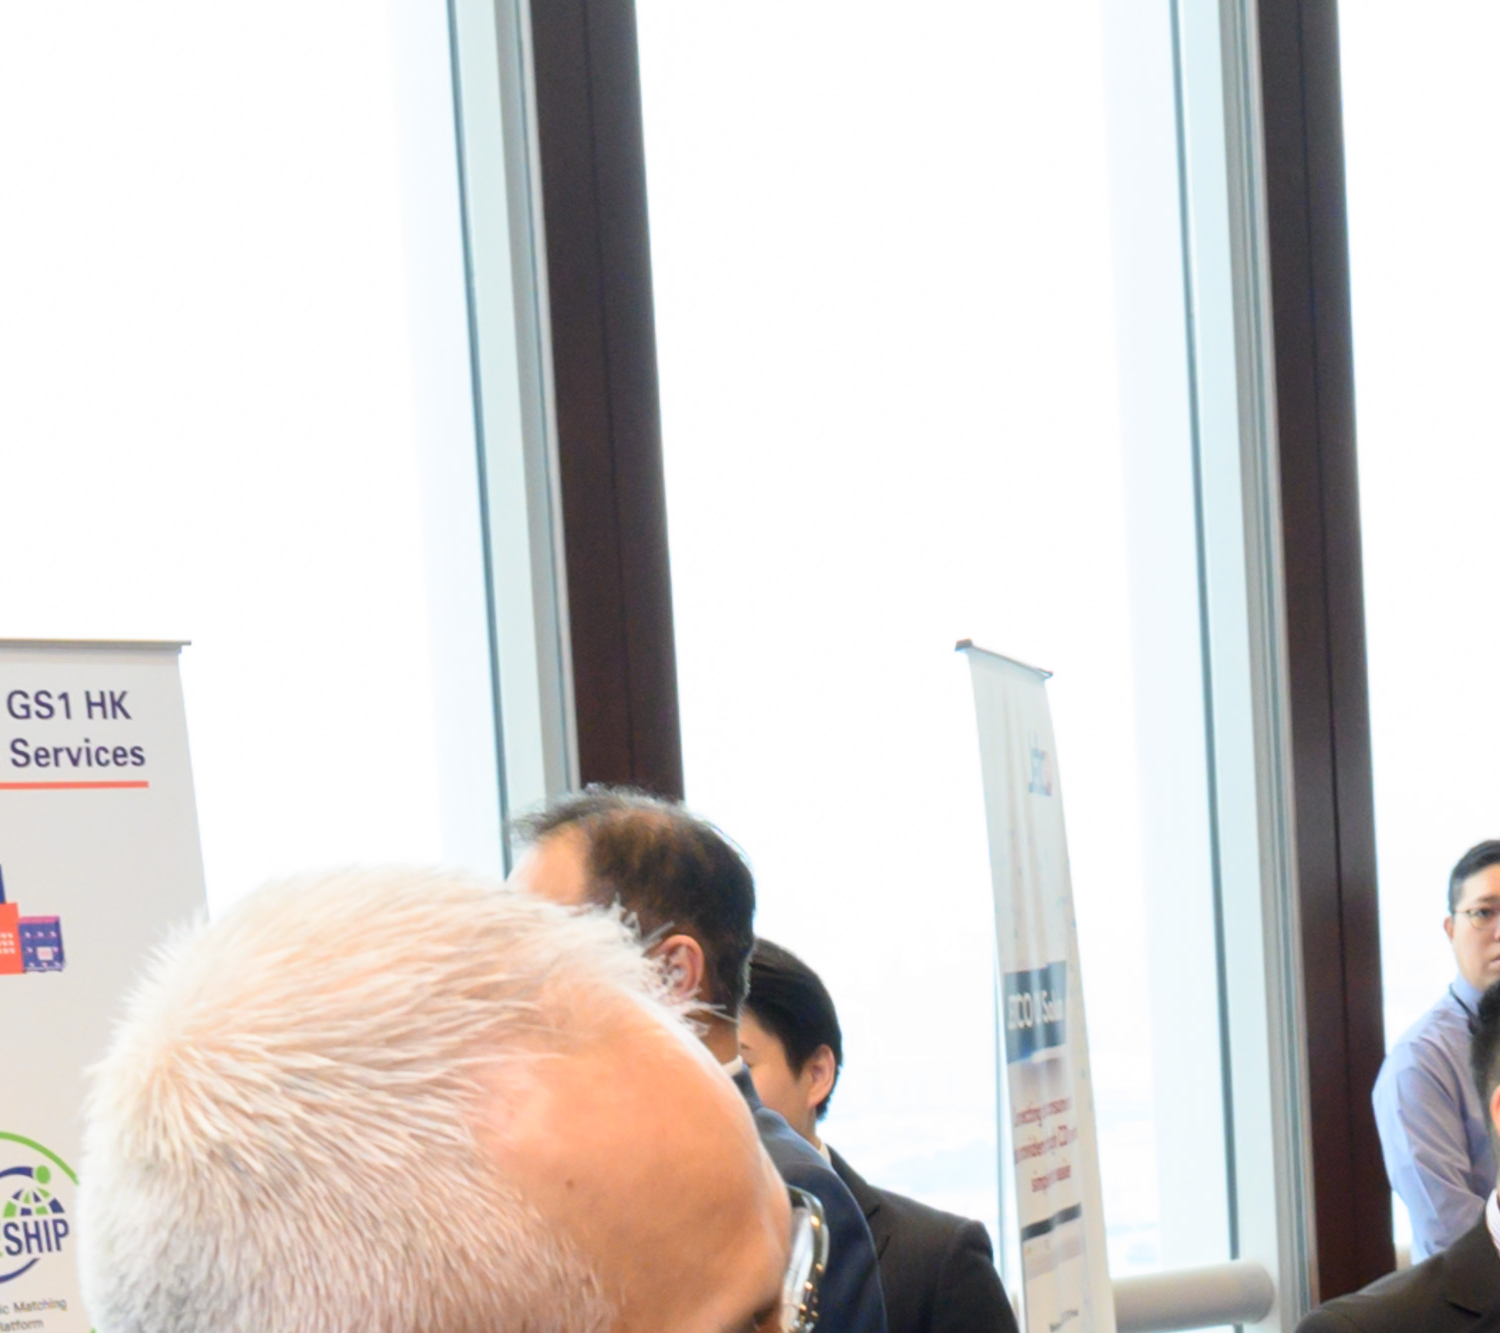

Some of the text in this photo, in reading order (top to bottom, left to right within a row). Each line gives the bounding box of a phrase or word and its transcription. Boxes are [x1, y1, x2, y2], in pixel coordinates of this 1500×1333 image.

[6, 690, 132, 720] GS1 HK
[9, 737, 147, 768] Services
[13, 1297, 68, 1313] Matching
